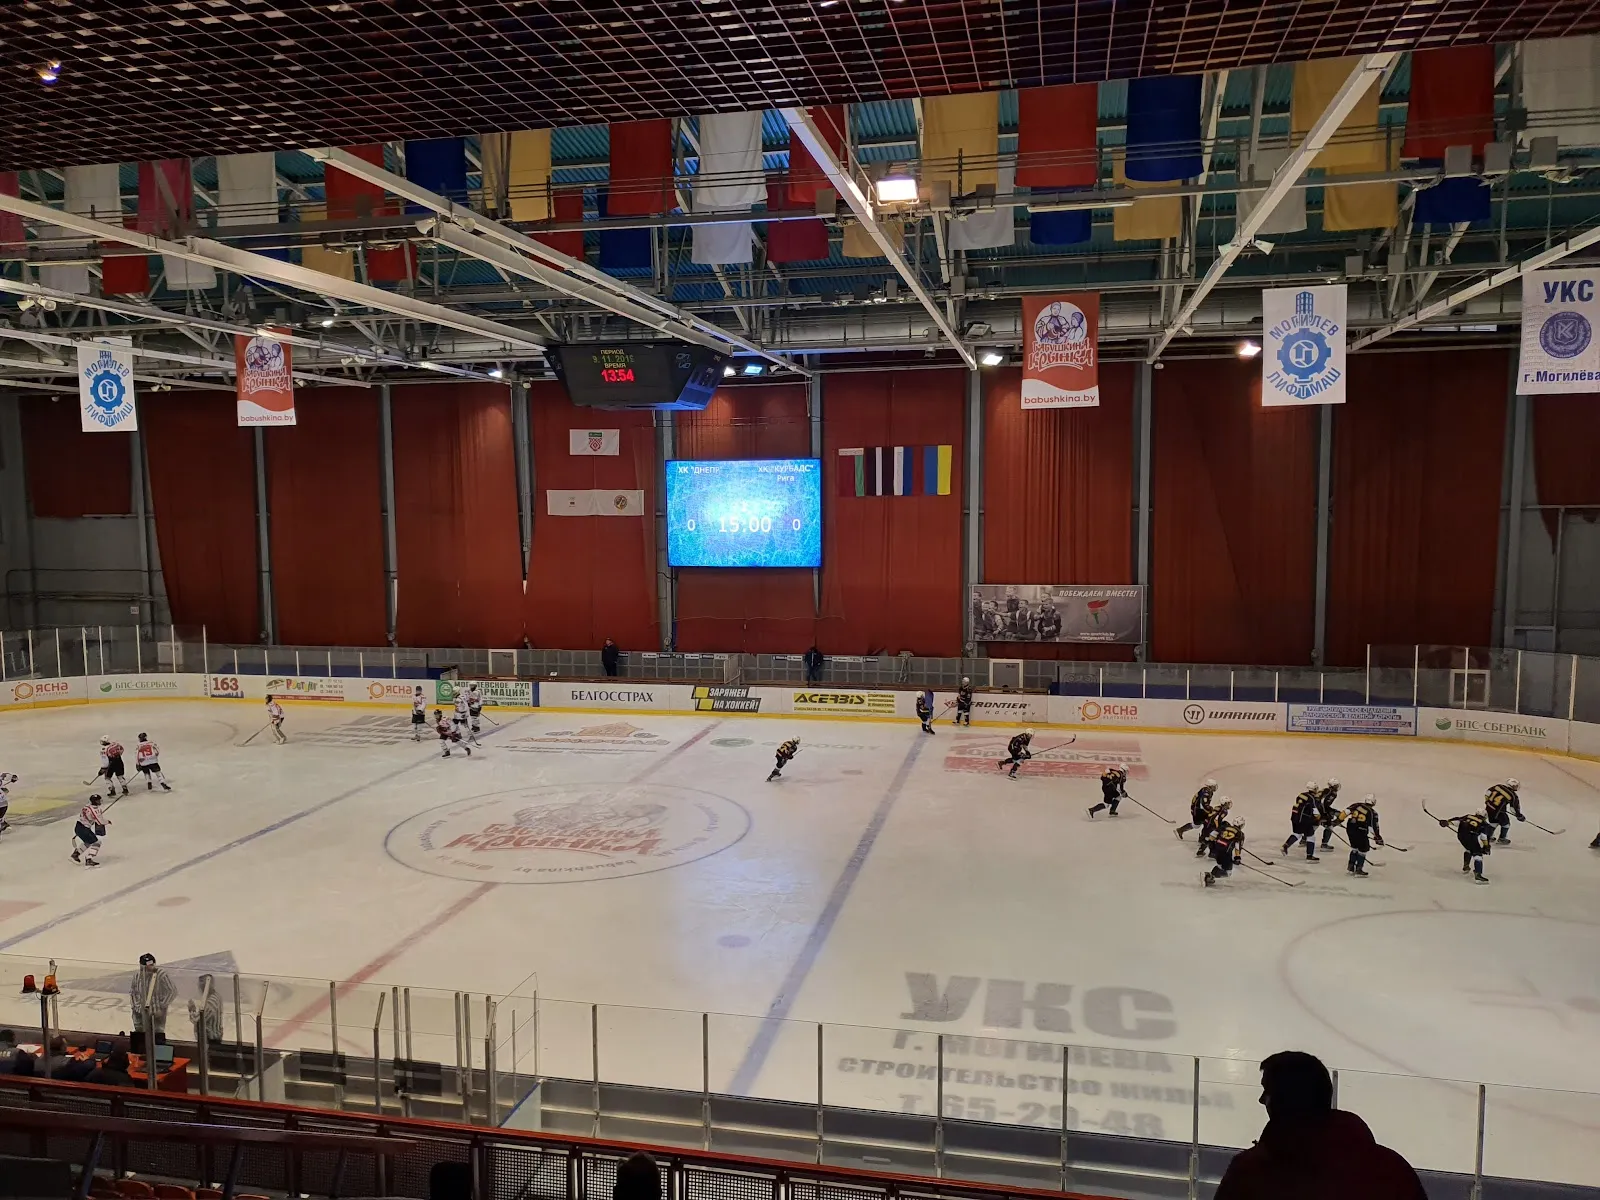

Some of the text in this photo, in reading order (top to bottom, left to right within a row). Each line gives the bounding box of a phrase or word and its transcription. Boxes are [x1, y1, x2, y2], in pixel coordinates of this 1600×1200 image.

[1543, 280, 1594, 303] УКС
[1269, 314, 1339, 340] МОГИЛЕВ
[84, 360, 130, 379] МОГИЛЕВ
[601, 369, 634, 382] 13:54
[1266, 367, 1341, 398] ЛИФТМАШ
[1024, 394, 1095, 404] babushkina.by
[84, 402, 133, 427] ЛИФТМАШ
[687, 519, 696, 531] 0
[718, 517, 772, 533] 15:00
[792, 518, 801, 531] 0
[1059, 589, 1104, 597] ПОБЕЖДАЕМ
[115, 681, 178, 690] БПС-СБЕРБАНК
[213, 677, 239, 691] 163
[571, 690, 653, 702] БЕЛГОССТРАХ
[709, 688, 748, 698] ЗАРЯЖЕН
[713, 700, 760, 710] НА ХОККЕЙ!
[1208, 710, 1278, 721] WARRIOR
[1455, 719, 1546, 737] БПС-СБЕРБАНК
[899, 971, 1178, 1041] УКС
[838, 1056, 1102, 1097] СТРОИТЕЛЬСТВО
